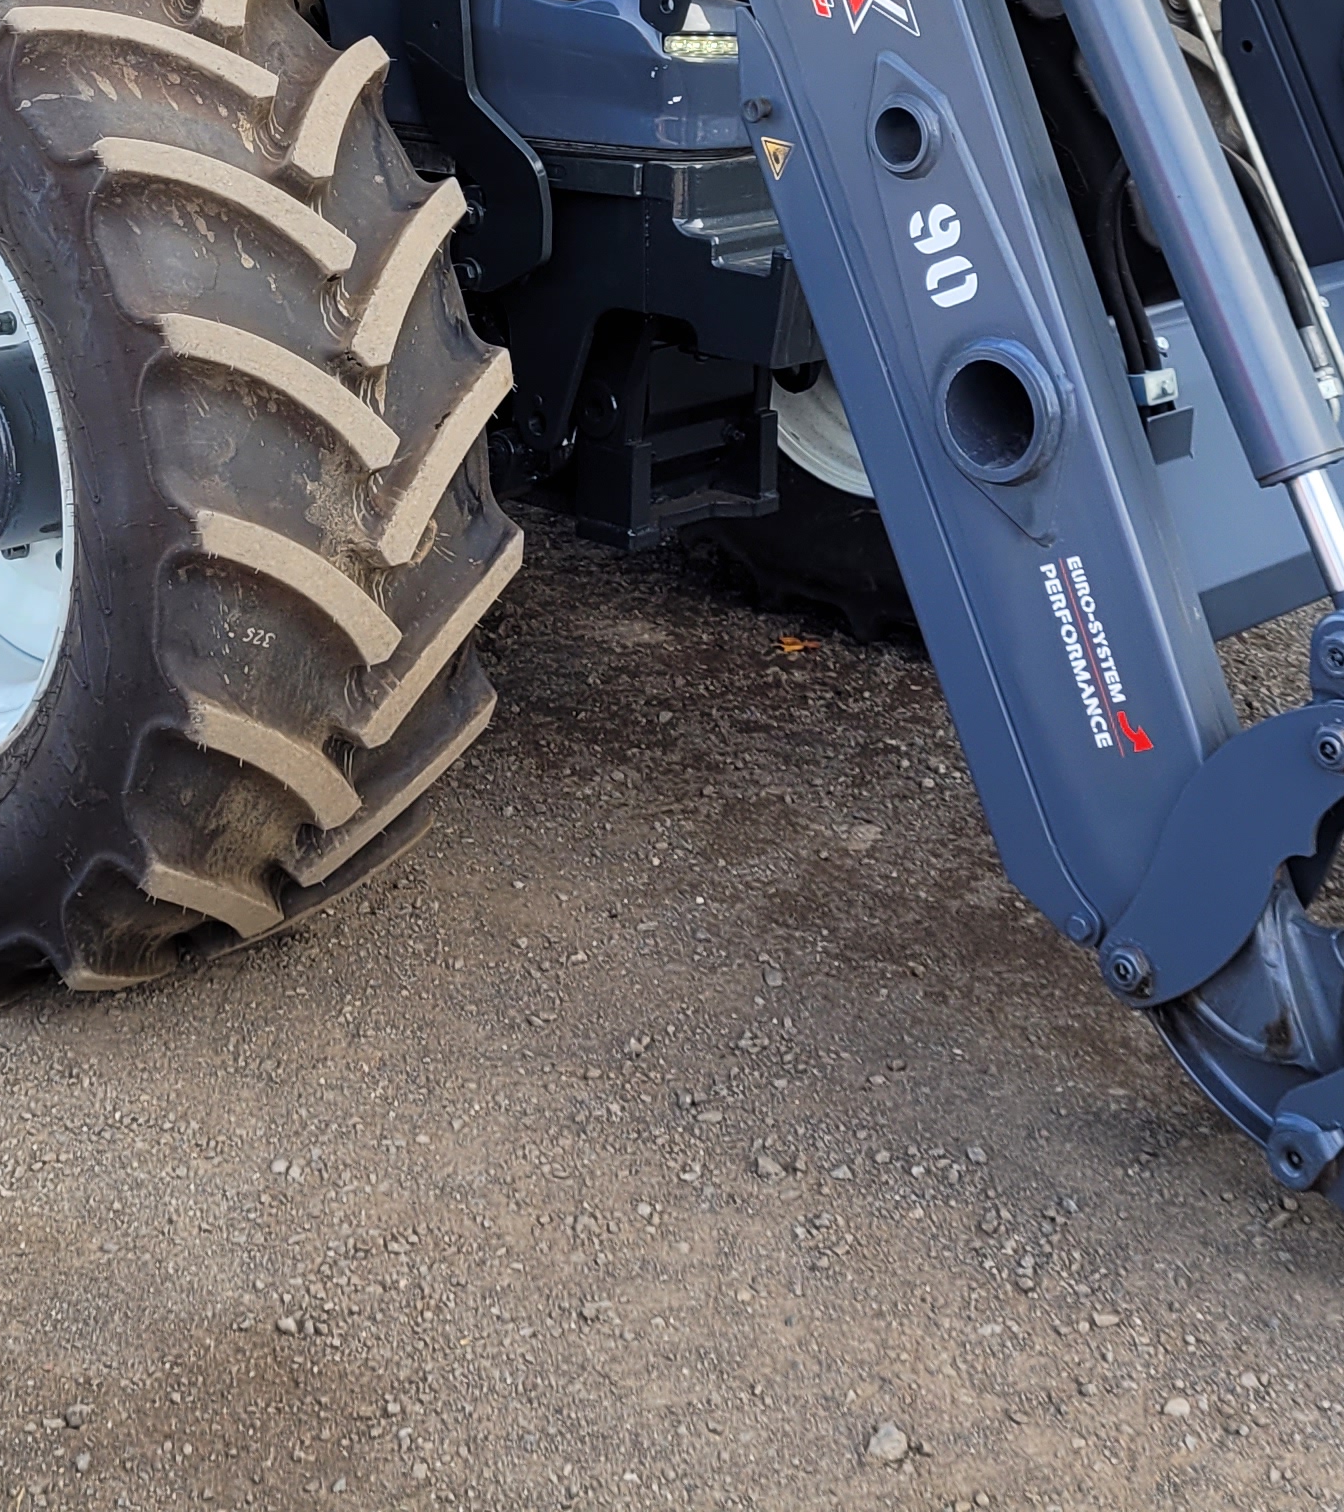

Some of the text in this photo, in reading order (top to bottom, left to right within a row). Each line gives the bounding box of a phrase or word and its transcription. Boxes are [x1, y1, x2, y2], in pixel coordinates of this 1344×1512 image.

[909, 203, 978, 308] 90
[1039, 562, 1114, 750] PERFORMANCE
[1065, 555, 1127, 704] EURO-SYSTEM
